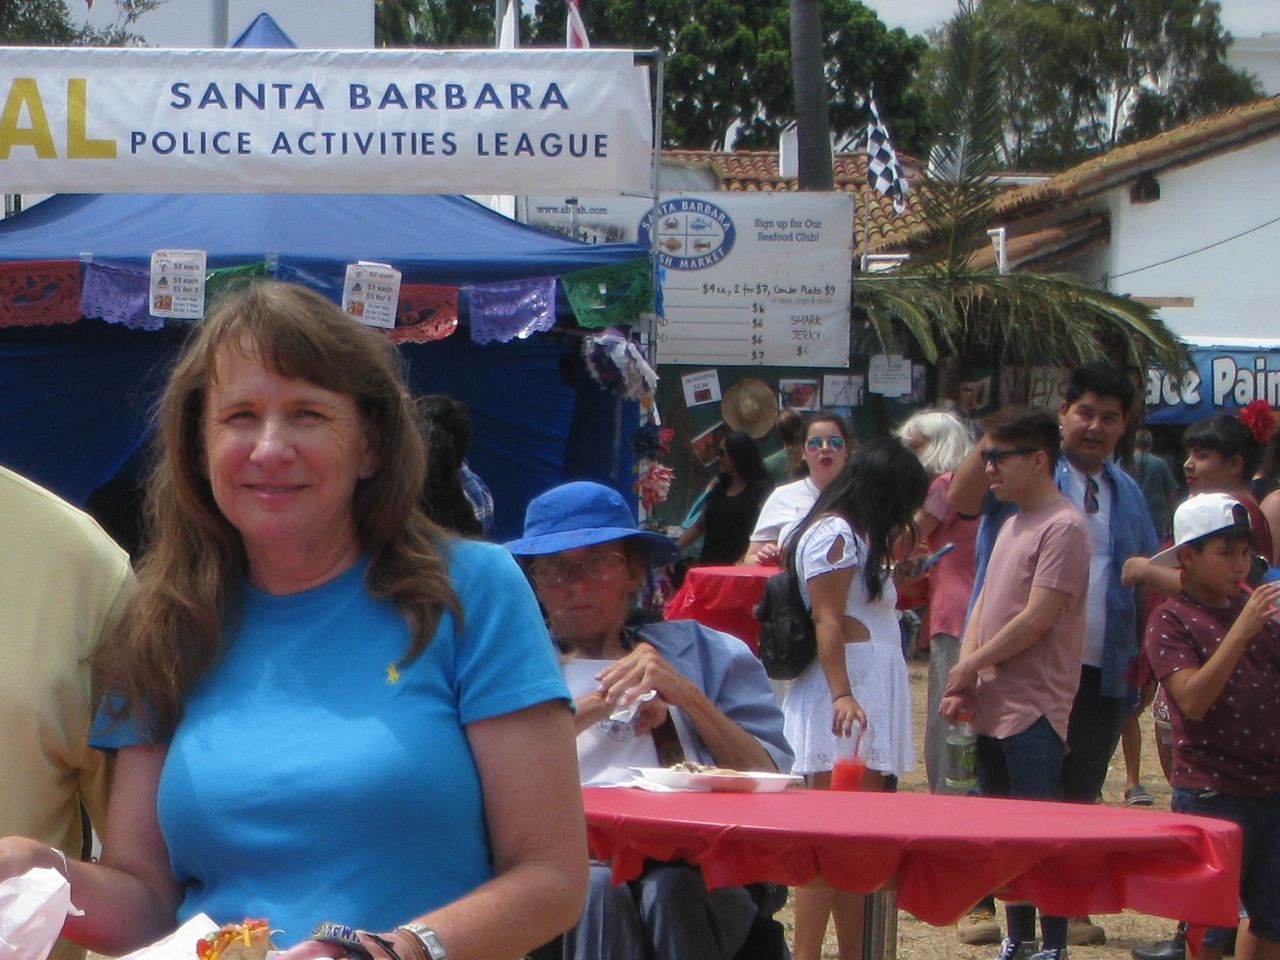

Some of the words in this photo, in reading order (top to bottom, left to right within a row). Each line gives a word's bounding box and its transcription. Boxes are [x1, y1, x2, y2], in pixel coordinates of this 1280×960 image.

[170, 82, 325, 110] SANTA
[349, 82, 569, 110] BARBARA
[130, 131, 251, 155] POLICE
[270, 131, 457, 156] ACTIVITIES
[477, 132, 608, 158] LEAGUE
[681, 200, 732, 230] BARBARA
[754, 219, 775, 230] Sign
[776, 221, 788, 230] up
[790, 219, 803, 229] for
[804, 219, 822, 229] Our
[757, 233, 793, 242] Seafood
[795, 233, 820, 242] Club!
[679, 248, 725, 269] MARKET
[1147, 369, 1201, 405] ace
